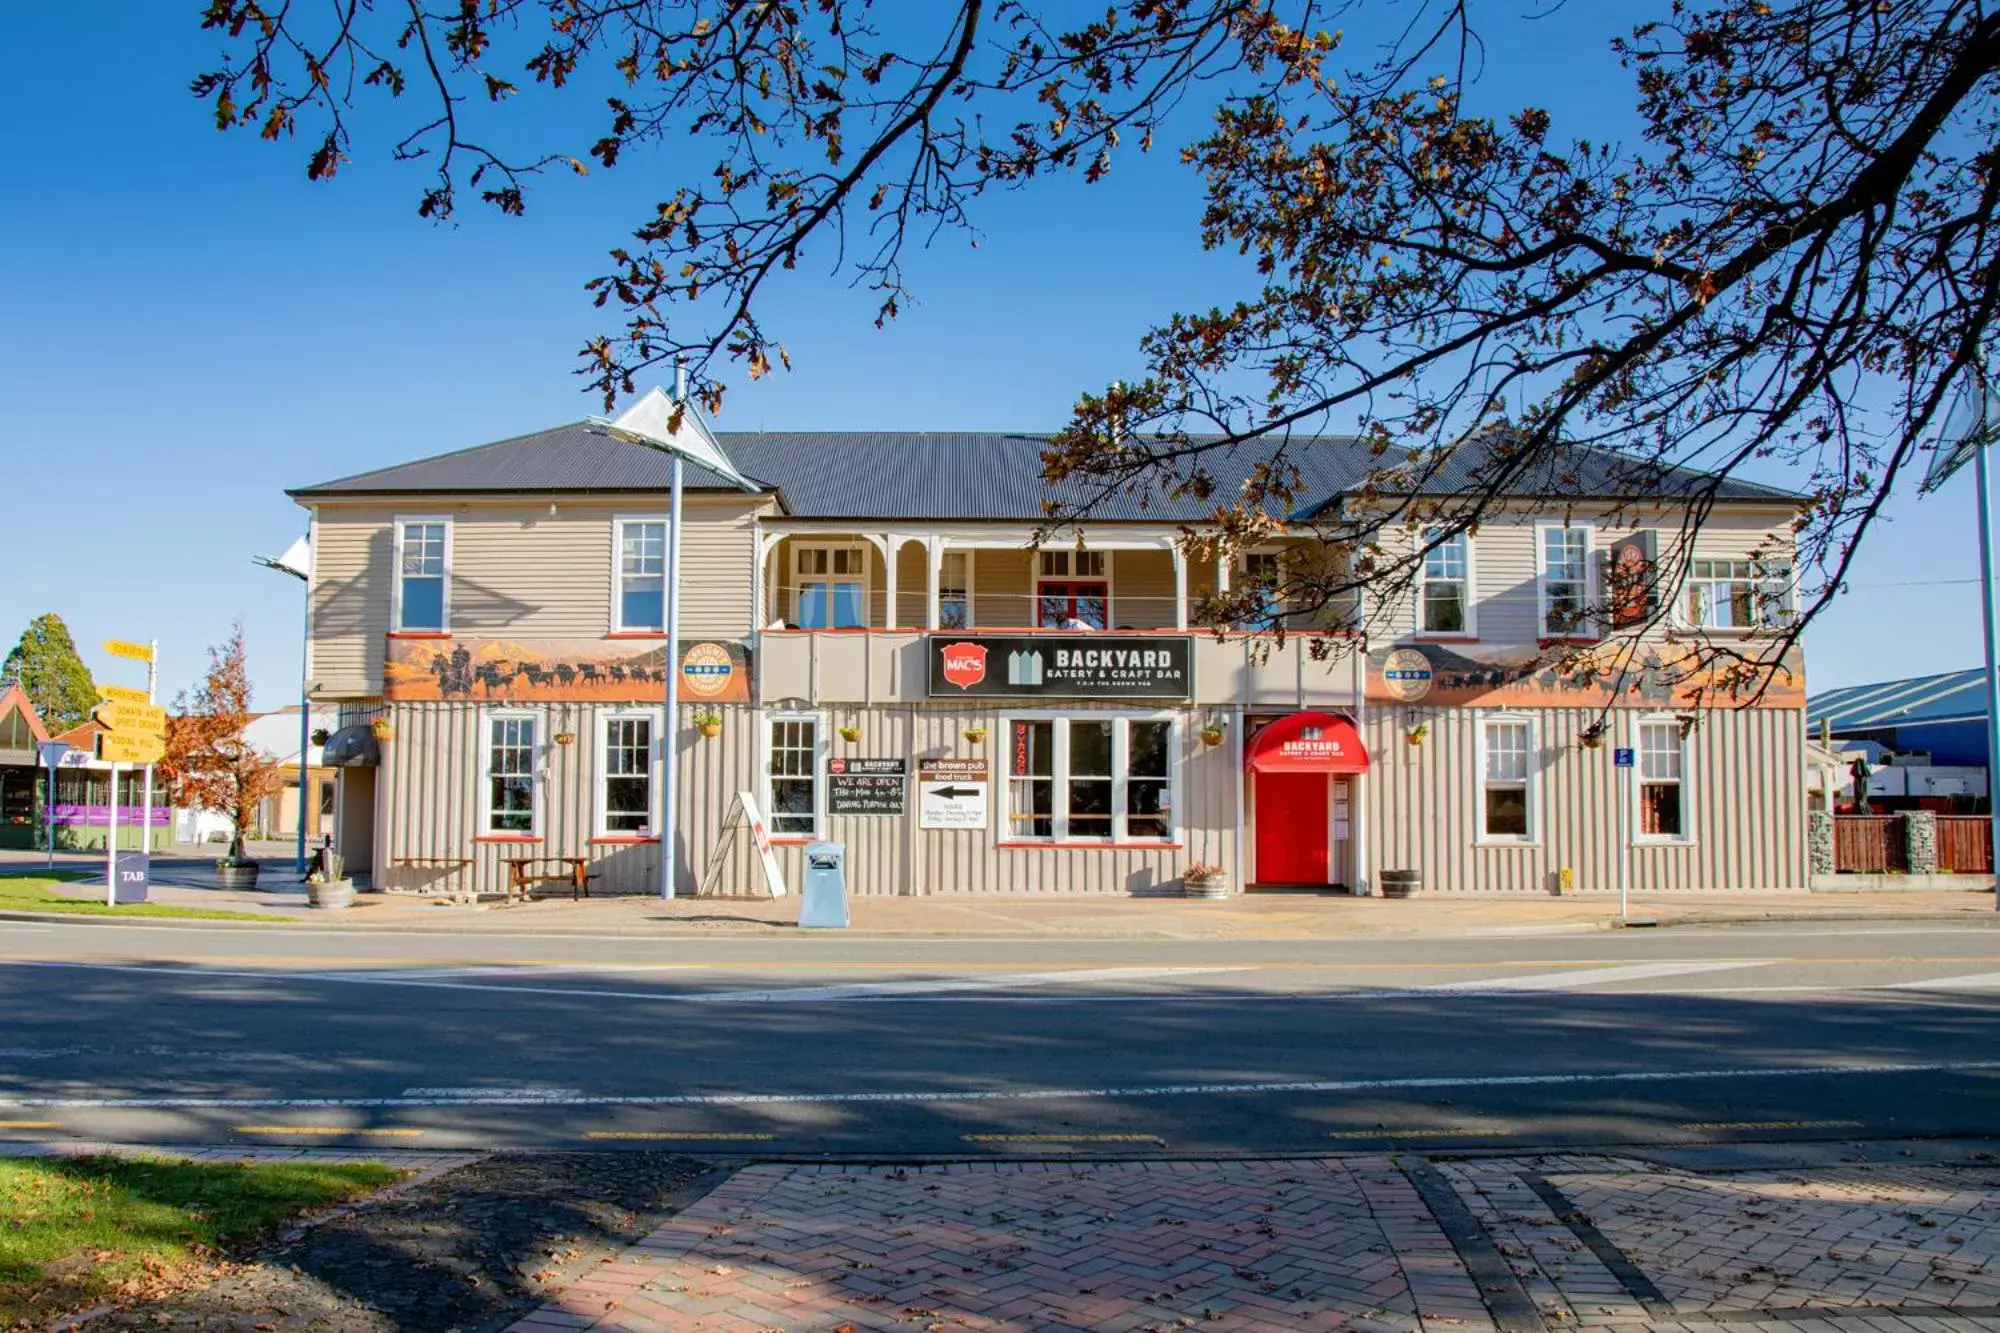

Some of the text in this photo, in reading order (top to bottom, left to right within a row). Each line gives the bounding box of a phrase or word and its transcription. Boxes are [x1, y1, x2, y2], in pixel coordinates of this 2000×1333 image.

[1056, 650, 1171, 668] BACKYARD
[946, 658, 982, 671] MAC'S
[1046, 669, 1181, 679] EATERY & CRAFT BAR
[1283, 741, 1340, 751] BACKYARD
[938, 760, 966, 770] brown
[967, 761, 985, 771] pub
[935, 772, 972, 780] food truck
[837, 777, 855, 786] WE
[856, 777, 873, 786] ARE
[121, 871, 145, 881] TAB
